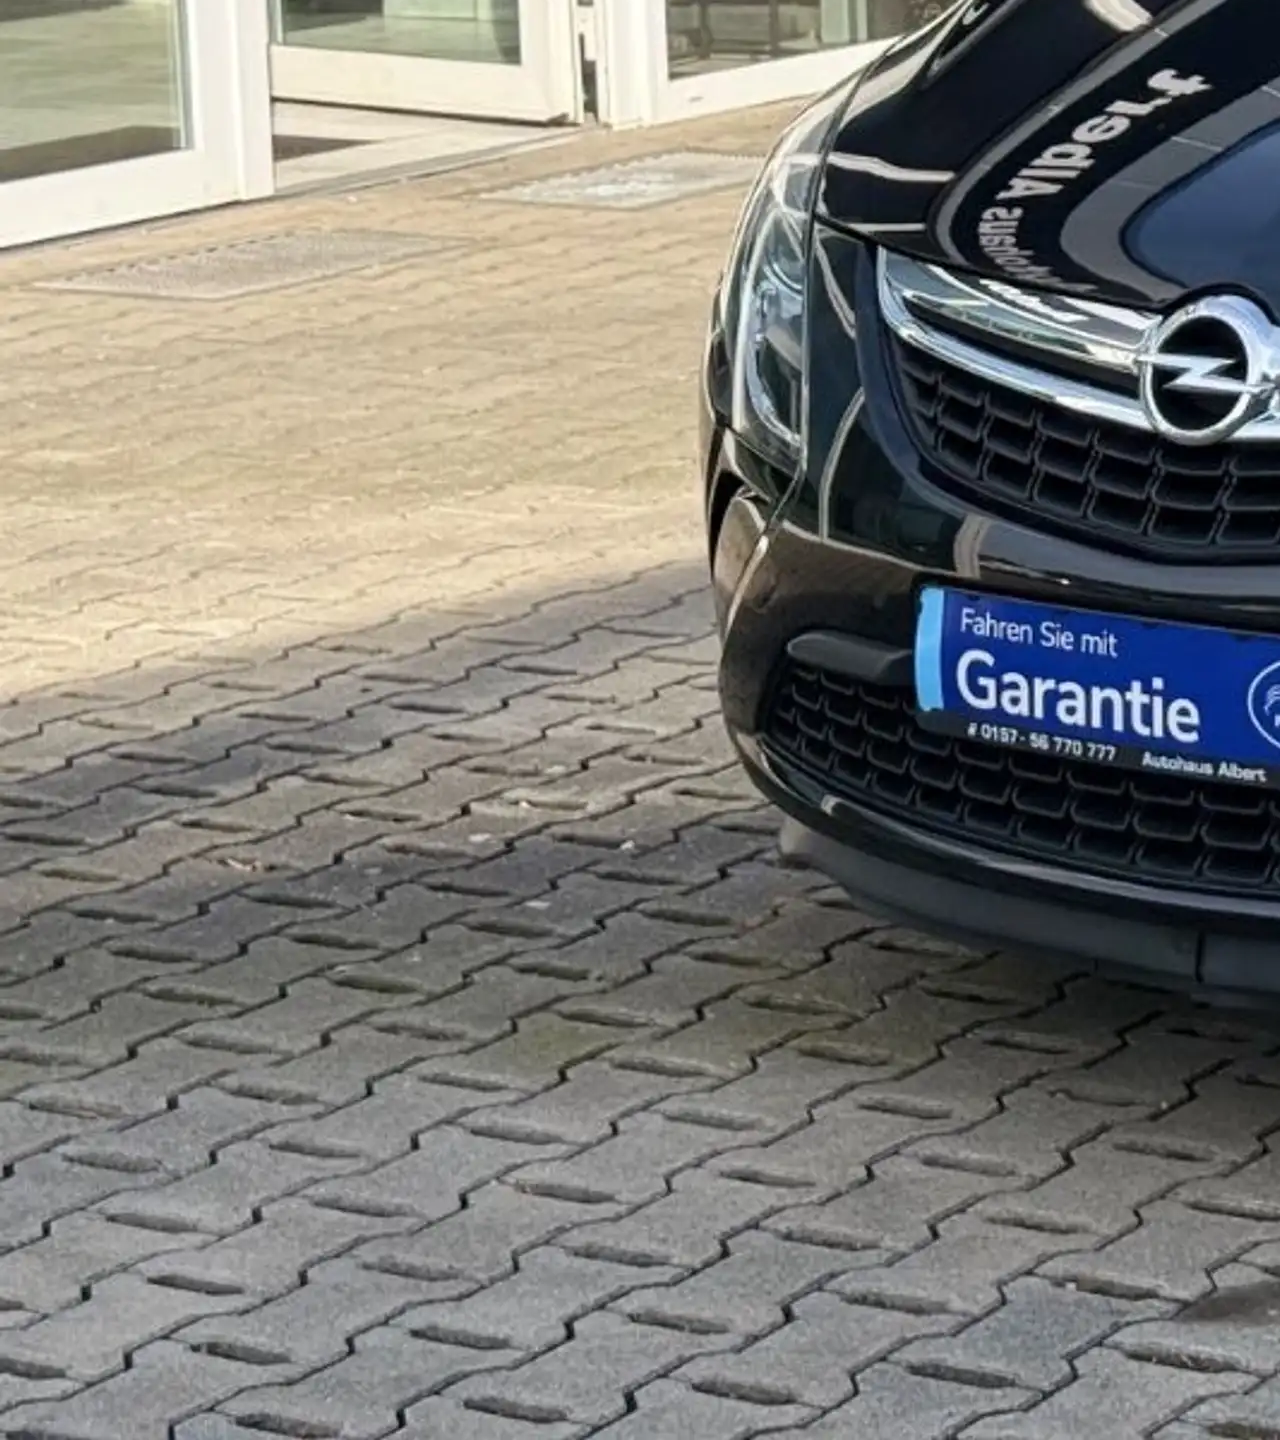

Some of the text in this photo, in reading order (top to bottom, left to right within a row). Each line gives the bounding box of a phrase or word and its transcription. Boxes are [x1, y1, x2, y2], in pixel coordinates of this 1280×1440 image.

[960, 608, 1118, 658] Fahren Sie mit
[956, 648, 1201, 744] Garantie
[1052, 736, 1083, 756] 770
[1086, 742, 1118, 761] 777
[1141, 751, 1267, 783] Autohaus Albert
